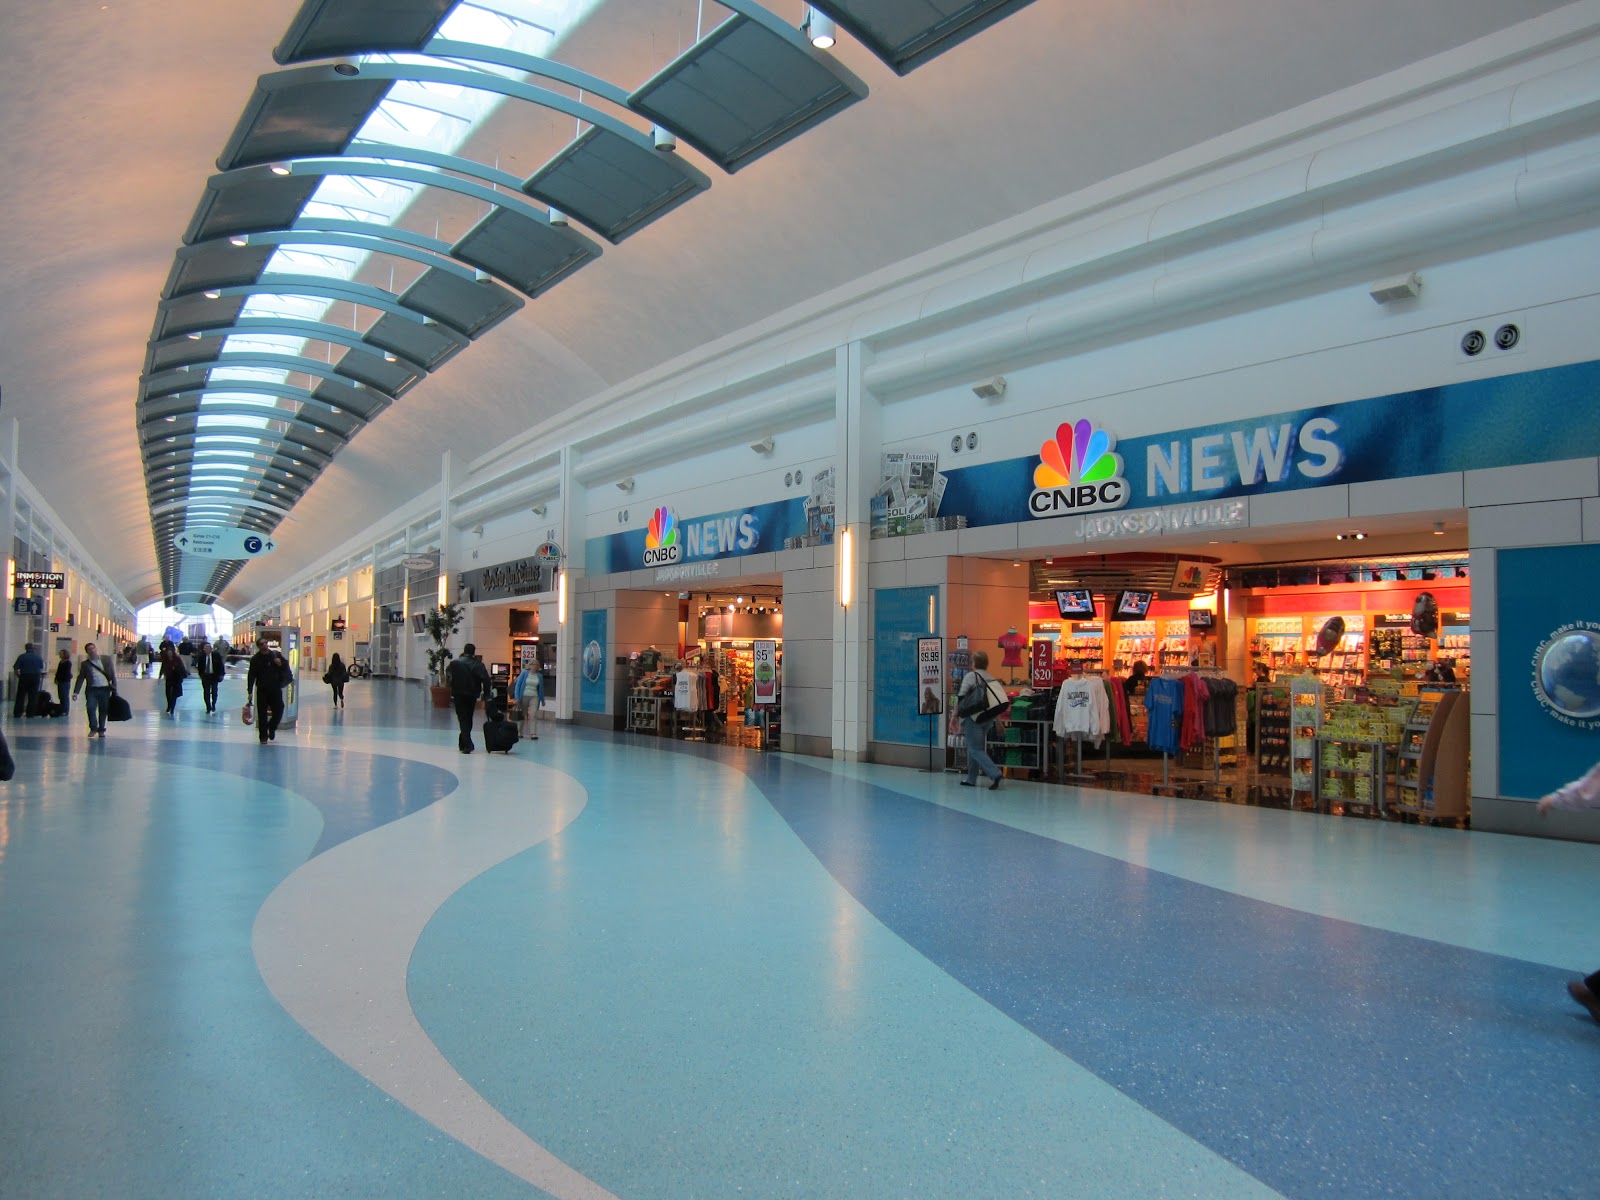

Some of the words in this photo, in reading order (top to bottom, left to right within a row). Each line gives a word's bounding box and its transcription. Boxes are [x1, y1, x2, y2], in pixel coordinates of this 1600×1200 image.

[1147, 418, 1342, 497] NEWS
[1031, 482, 1122, 512] CNBC
[906, 513, 927, 521] BEACH
[1075, 502, 1243, 538] JACKSONVILLE
[687, 514, 755, 557] NEWS
[249, 541, 257, 550] C
[644, 546, 677, 564] CNBC
[17, 572, 63, 581] INMOTION
[657, 562, 718, 581] JACKSONVILLE
[1549, 623, 1575, 639] make
[1576, 620, 1584, 629] it
[1586, 622, 1600, 630] yo
[522, 650, 535, 659] $25
[921, 651, 939, 662] $9.99
[1039, 643, 1047, 657] 2
[1034, 668, 1051, 681] $20
[1549, 709, 1576, 726] make
[1578, 720, 1586, 728] it
